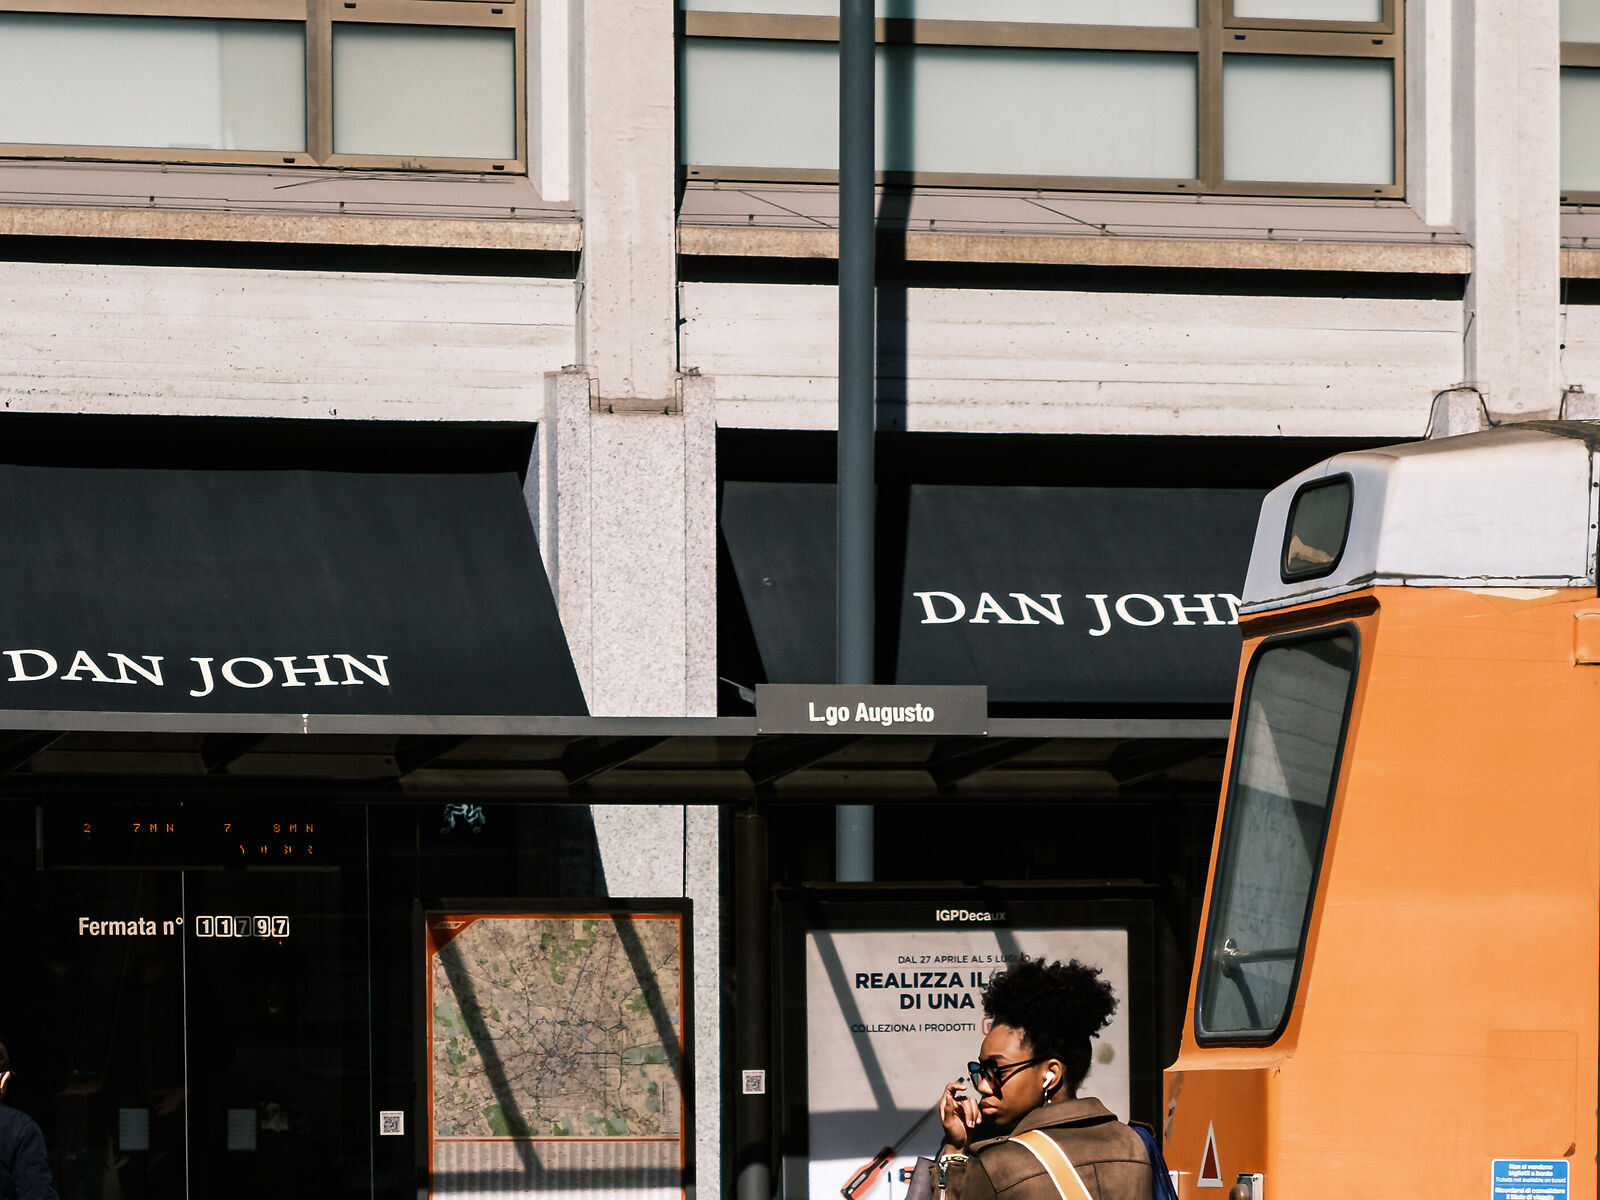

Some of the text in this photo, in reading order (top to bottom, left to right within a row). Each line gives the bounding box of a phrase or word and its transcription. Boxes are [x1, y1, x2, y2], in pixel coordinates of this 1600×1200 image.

[912, 591, 1065, 626] DAN
[3, 649, 391, 697] DAN JOHN
[808, 701, 935, 727] L.go Augusto
[935, 909, 1006, 921] IGPDecaux
[78, 916, 288, 936] Fermata n° 11797
[898, 955, 918, 964] DAL
[920, 955, 931, 964] 27
[934, 955, 968, 964] APRILE
[971, 954, 984, 963] AL
[987, 954, 993, 963] 5
[855, 972, 964, 989] REALIZZA
[970, 971, 988, 988] IL
[899, 992, 976, 1010] DI UNA
[851, 1023, 917, 1033] COLLEZIONA
[925, 1023, 976, 1032] PRODOTTI
